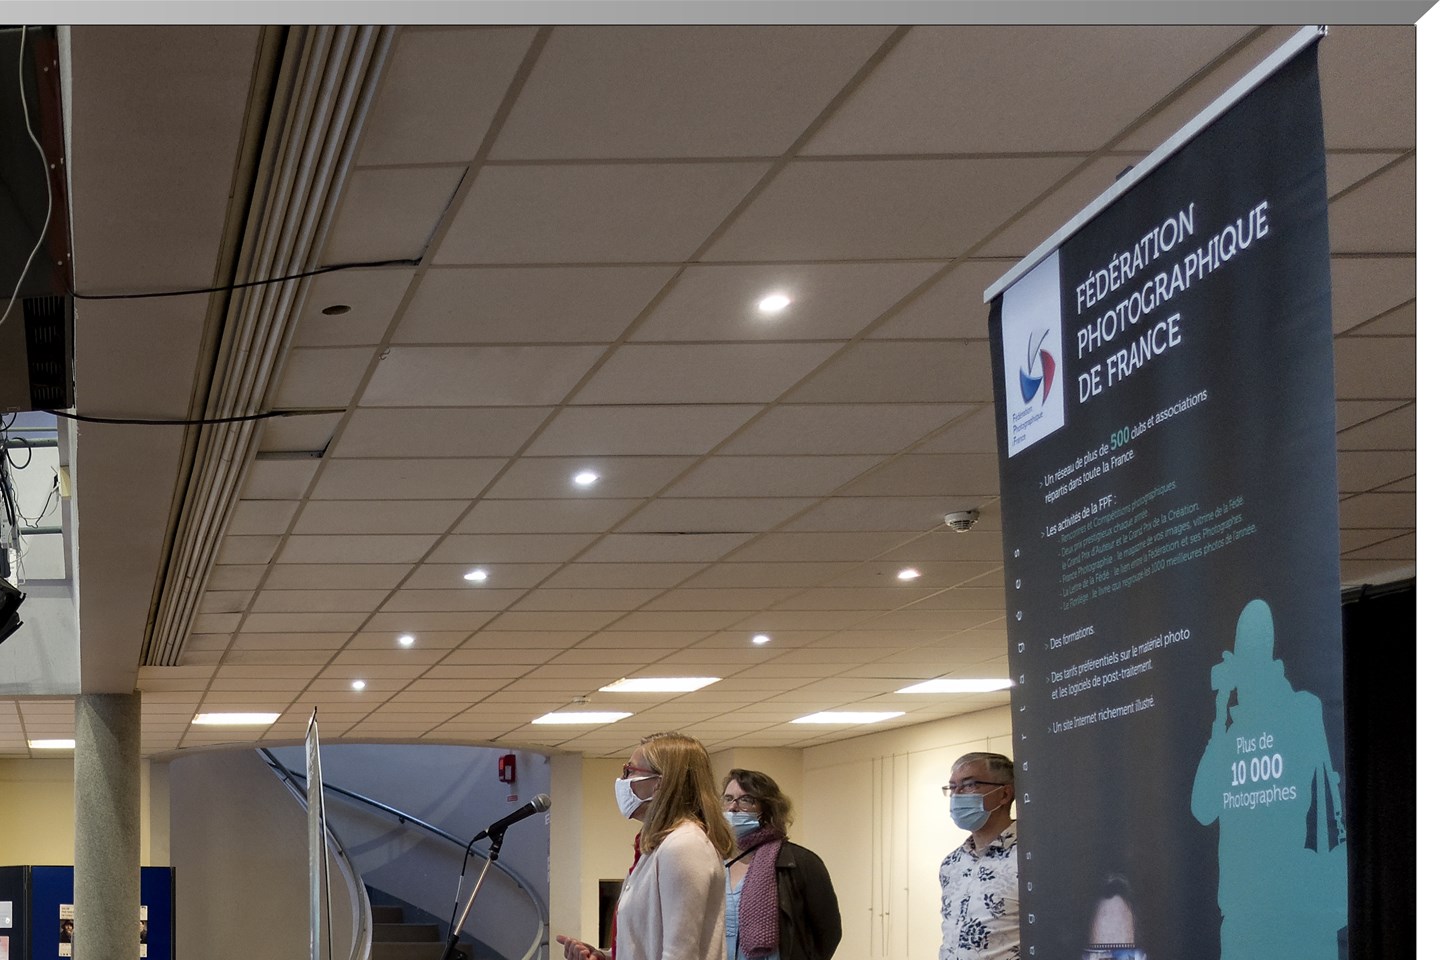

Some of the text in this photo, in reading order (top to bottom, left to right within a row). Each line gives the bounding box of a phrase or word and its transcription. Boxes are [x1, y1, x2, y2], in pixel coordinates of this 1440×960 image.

[1076, 202, 1195, 315] FÉDÉRATION
[1078, 201, 1270, 359] PHOTOGRAPHIQUE
[1078, 313, 1182, 404] DE FRANCE
[1044, 389, 1208, 487] Un réseau de plus de 500 clubs et associations
[1044, 483, 1068, 504] répartis
[1068, 476, 1082, 492] dans
[1082, 466, 1101, 482] toute
[1102, 461, 1110, 474] la
[1046, 524, 1057, 537] Les
[1058, 510, 1081, 532] activités
[1082, 506, 1090, 519] de
[1090, 502, 1098, 514] la
[1050, 638, 1062, 650] Des
[1050, 628, 1191, 683] Des tarifs préférentiels sur le matériel photo
[1051, 690, 1059, 700] et
[1059, 686, 1068, 698] les
[1068, 678, 1092, 696] logiciels
[1092, 674, 1102, 687] de
[1052, 721, 1062, 734] Un
[1063, 719, 1073, 732] site
[1098, 702, 1134, 721] richement
[1236, 732, 1274, 755] Plus de
[1231, 753, 1283, 787] 10 000
[1222, 784, 1297, 810] Photographes
